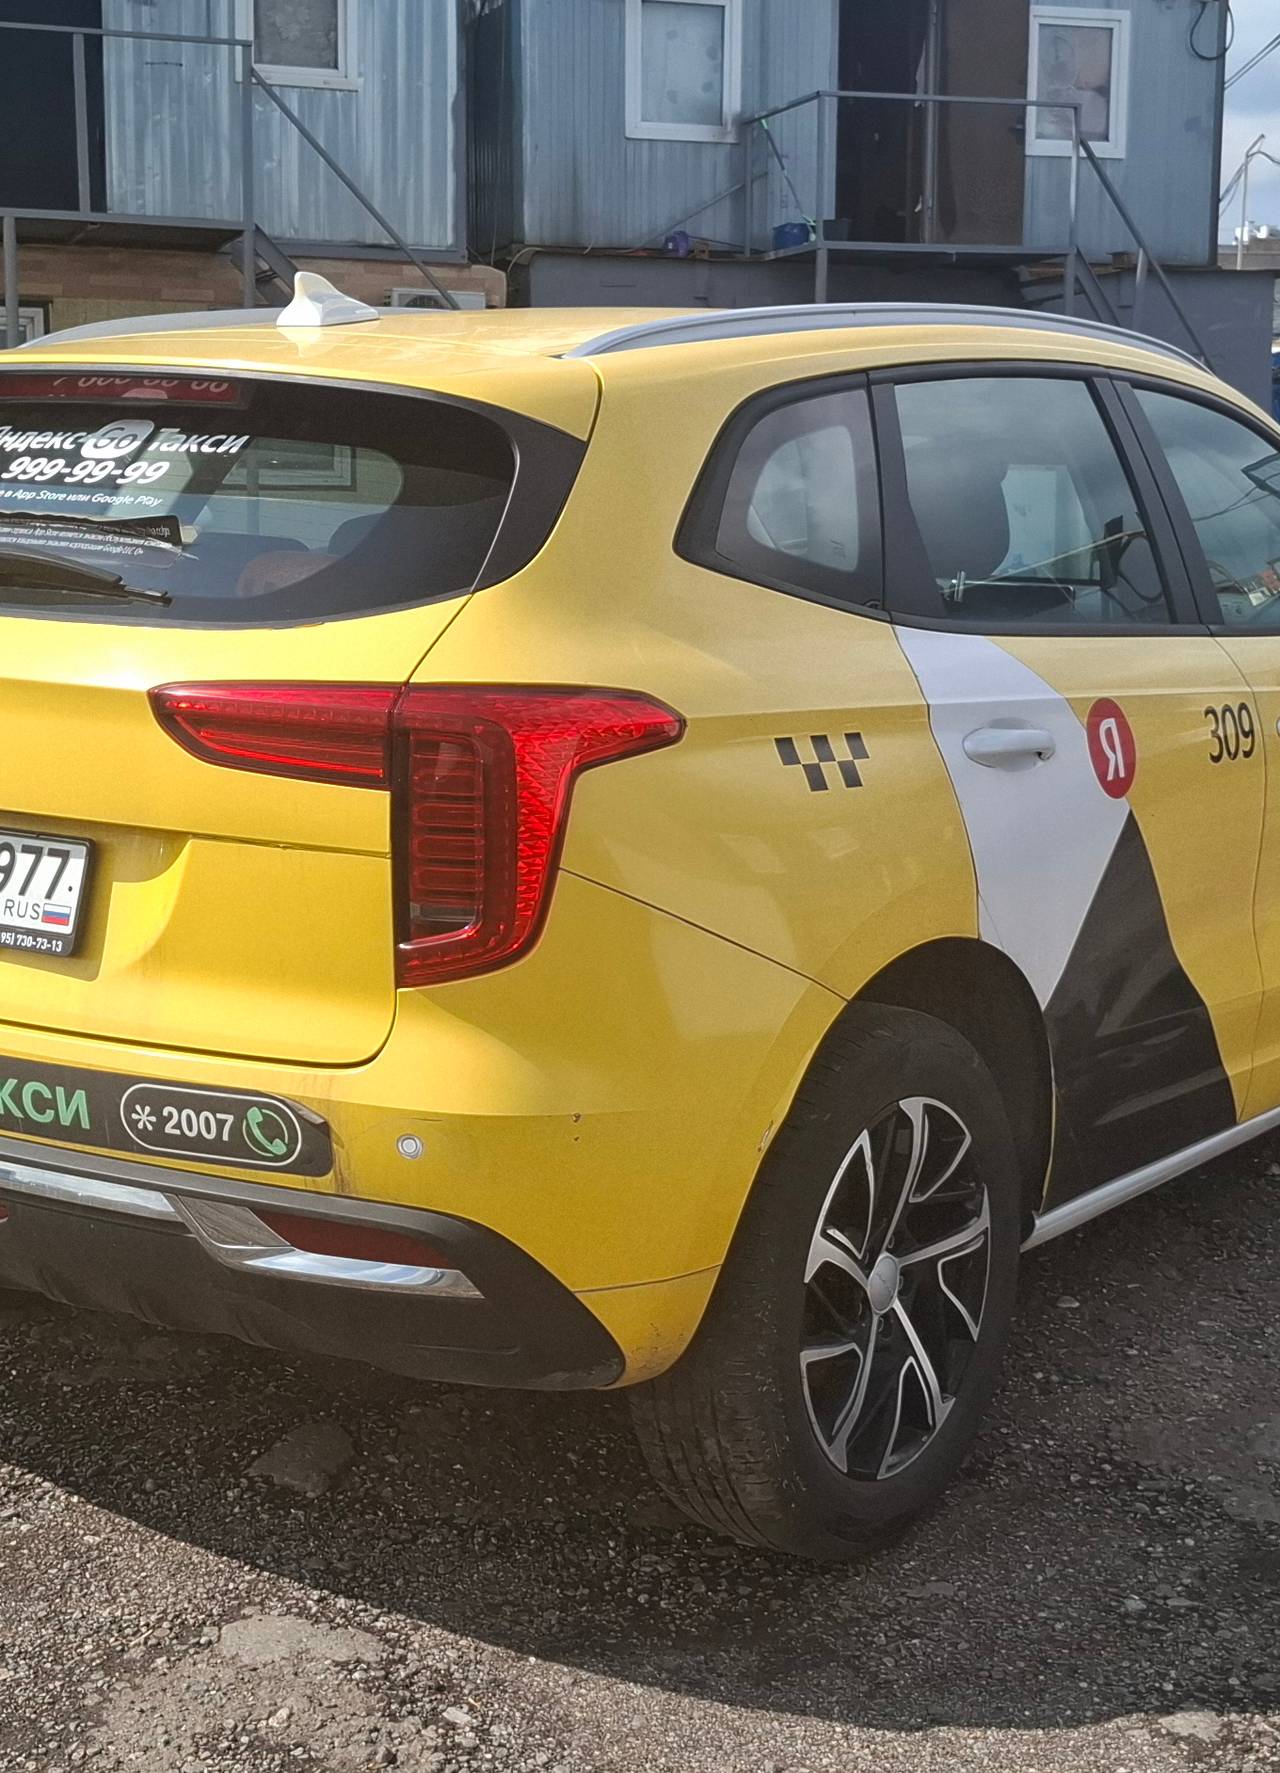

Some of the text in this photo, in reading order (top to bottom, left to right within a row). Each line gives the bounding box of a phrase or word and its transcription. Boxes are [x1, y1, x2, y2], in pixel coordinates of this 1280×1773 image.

[146, 428, 250, 454] Такси
[0, 455, 170, 484] 999-99-99
[12, 489, 35, 500] App
[36, 490, 67, 501] Store
[66, 493, 92, 502] или
[91, 493, 134, 505] Google
[1204, 702, 1256, 764] 309
[1099, 718, 1125, 780] Я
[3, 899, 41, 920] RUS
[16, 933, 63, 952] 730-73-13
[162, 1105, 235, 1142] 2007
